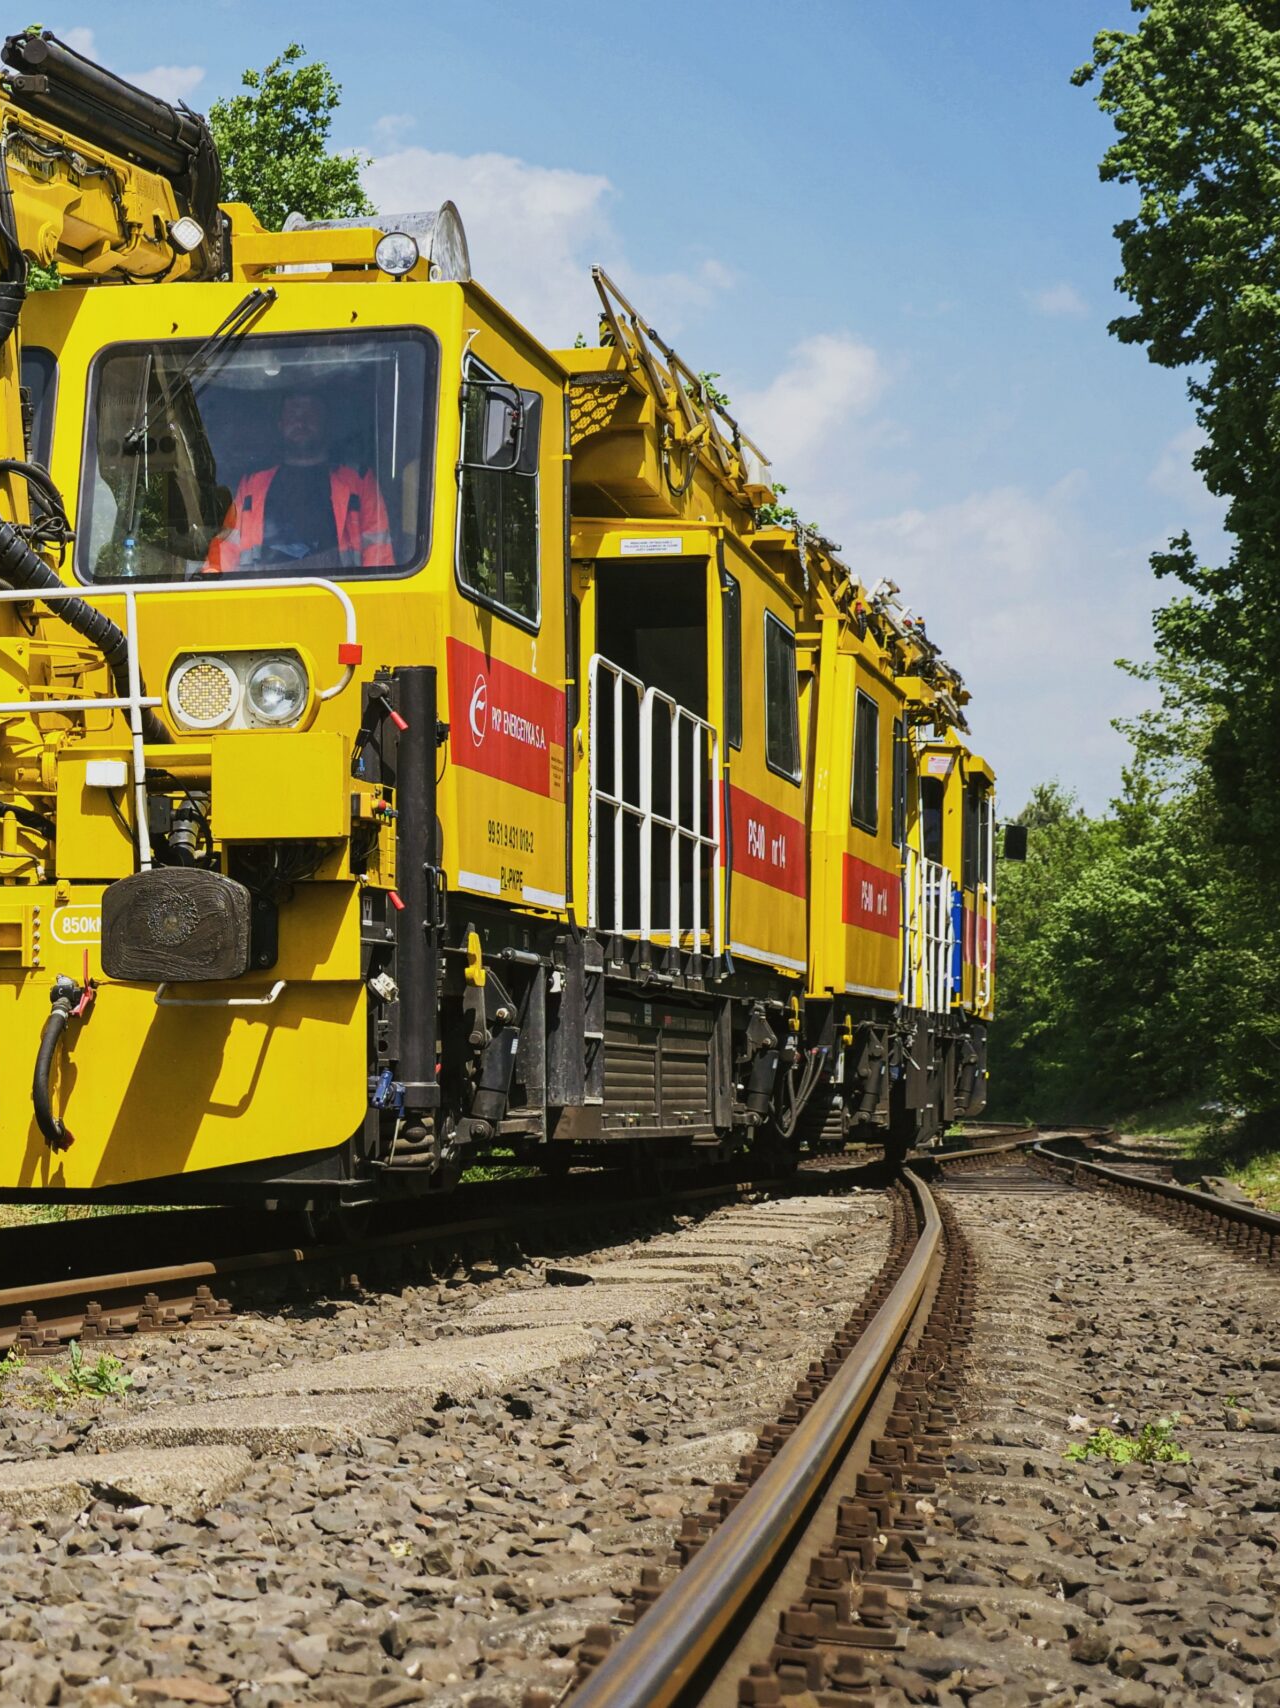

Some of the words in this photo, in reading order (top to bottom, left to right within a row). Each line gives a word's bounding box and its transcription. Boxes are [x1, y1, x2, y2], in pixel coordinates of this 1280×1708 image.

[531, 640, 537, 674] 2
[491, 706, 501, 732] PKP
[503, 710, 535, 746] ENERGETYKA
